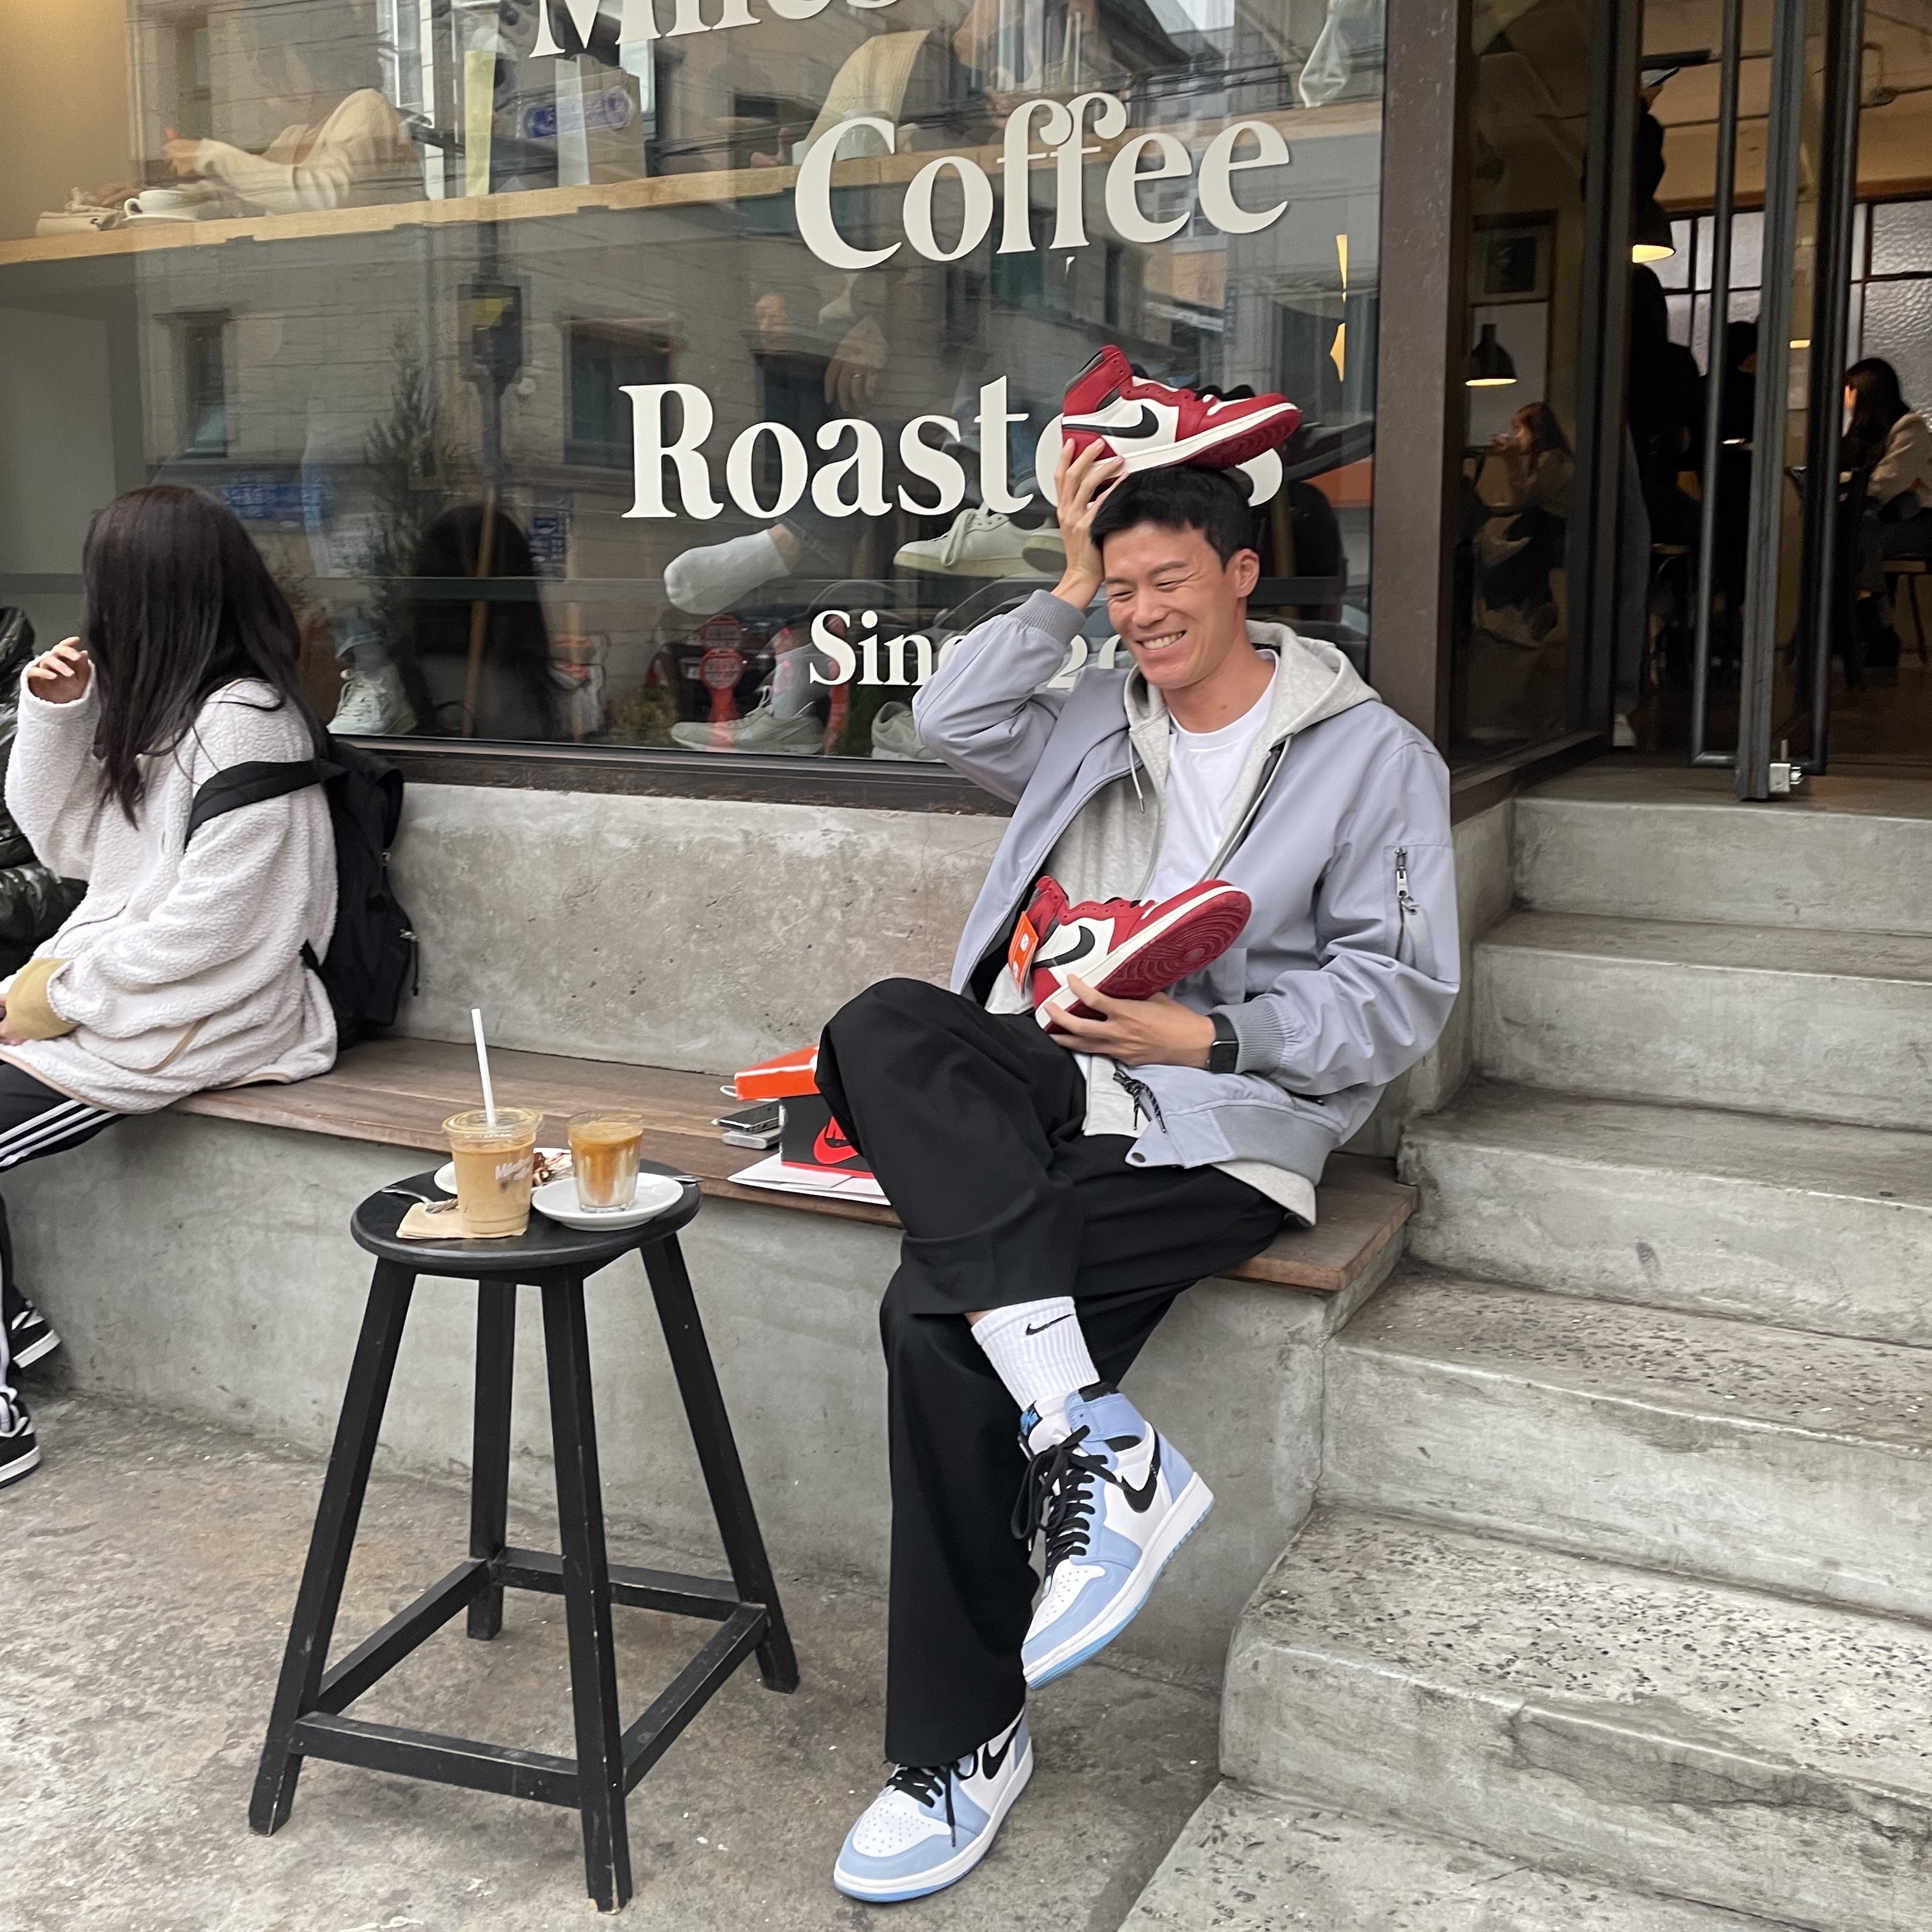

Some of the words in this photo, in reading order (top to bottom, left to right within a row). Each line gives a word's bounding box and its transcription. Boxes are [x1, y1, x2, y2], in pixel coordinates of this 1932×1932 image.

[794, 92, 1290, 269] Coffee
[618, 375, 1283, 519] Roast
[809, 610, 961, 686] Sin
